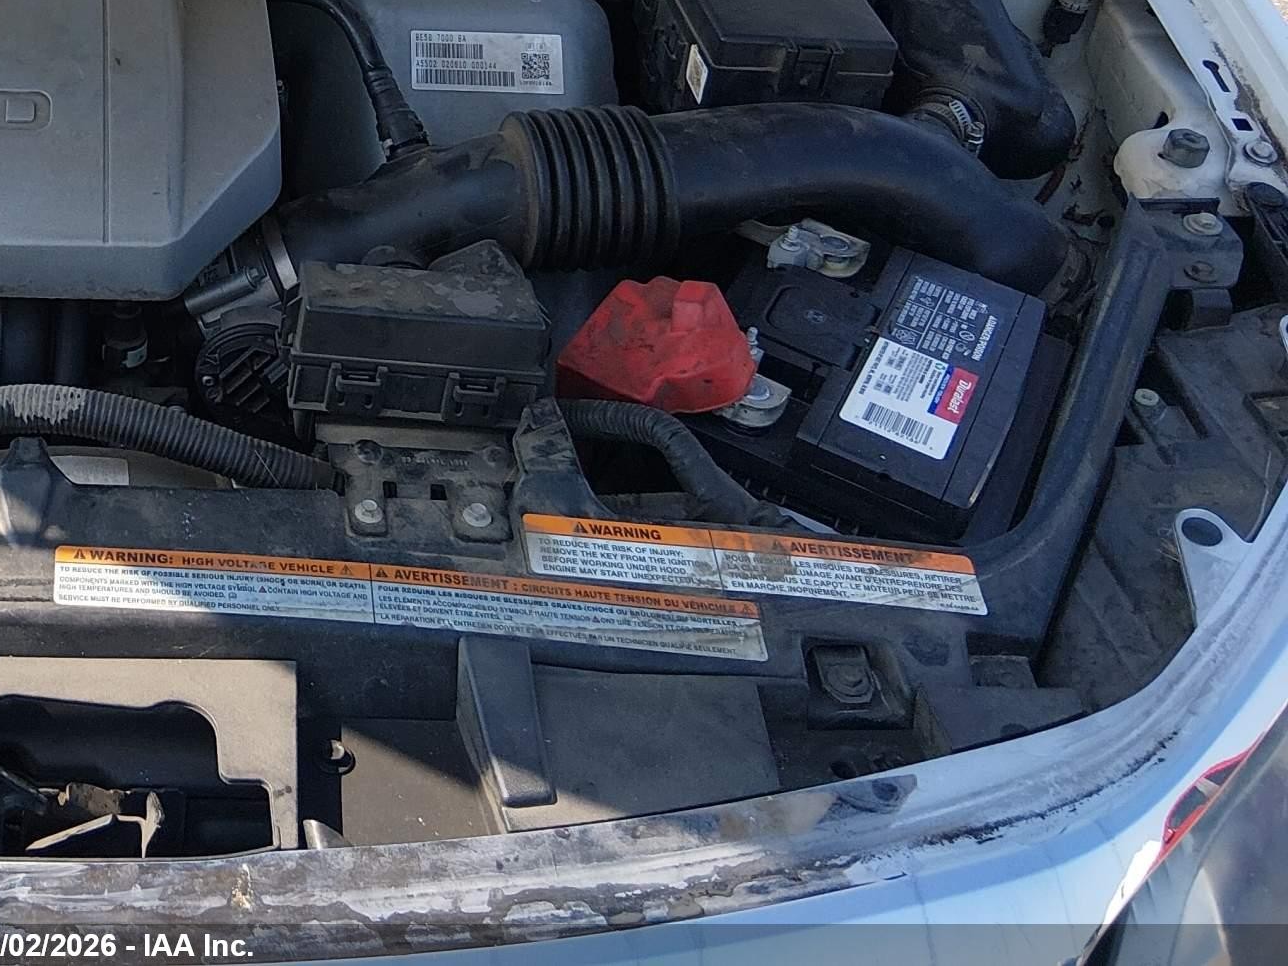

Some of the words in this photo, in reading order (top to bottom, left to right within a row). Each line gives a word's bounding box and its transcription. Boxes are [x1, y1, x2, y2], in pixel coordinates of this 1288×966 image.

[979, 318, 995, 341] DANGER
[971, 339, 987, 361] POISON
[945, 377, 972, 415] Duralast
[589, 524, 662, 540] WARNING
[539, 537, 550, 546] TO
[553, 538, 590, 549] REDUCE
[592, 541, 609, 551] THE
[612, 543, 632, 553] RISK
[635, 546, 646, 554] OF
[790, 541, 912, 562] AVERTISSEMENT
[90, 550, 174, 564] WARNING:
[182, 556, 213, 566] HIGH
[218, 558, 275, 570] VOLTAGE
[280, 563, 334, 574] VEHICLE
[542, 555, 578, 565] BEFORE
[580, 559, 624, 569] WORKING
[626, 563, 657, 572] UNDER
[581, 550, 598, 559] THE
[601, 552, 617, 560] KEY
[621, 554, 647, 563] FROM
[649, 556, 666, 565] THE
[192, 572, 224, 580] SERIOUS
[226, 574, 254, 582] INJURY
[543, 564, 577, 573] ENGINE
[580, 567, 598, 575] MAY
[601, 569, 629, 578] START
[813, 562, 852, 572] RISQUES
[924, 574, 961, 584] RETIRER
[394, 570, 508, 590] AVERTISSEMENT
[521, 585, 571, 596] CIRCUITS
[575, 590, 611, 600] HAUTE
[614, 594, 660, 606] TENSION
[664, 598, 678, 607] DU
[732, 580, 744, 588] EN
[746, 582, 785, 592] MARCHE
[834, 574, 862, 582] AVANT
[944, 584, 962, 592] DES
[267, 587, 299, 595] CONTAIN
[300, 589, 318, 597] HIGH
[317, 590, 351, 599] VOLTAGE
[454, 591, 488, 601] RISQUES
[504, 597, 548, 606] BLESSURES
[552, 601, 582, 610] GRAVES
[863, 585, 900, 594] MOTEUR
[941, 592, 976, 602] METTRE
[217, 602, 260, 611] PERSONNEL
[560, 613, 590, 621] TENSION
